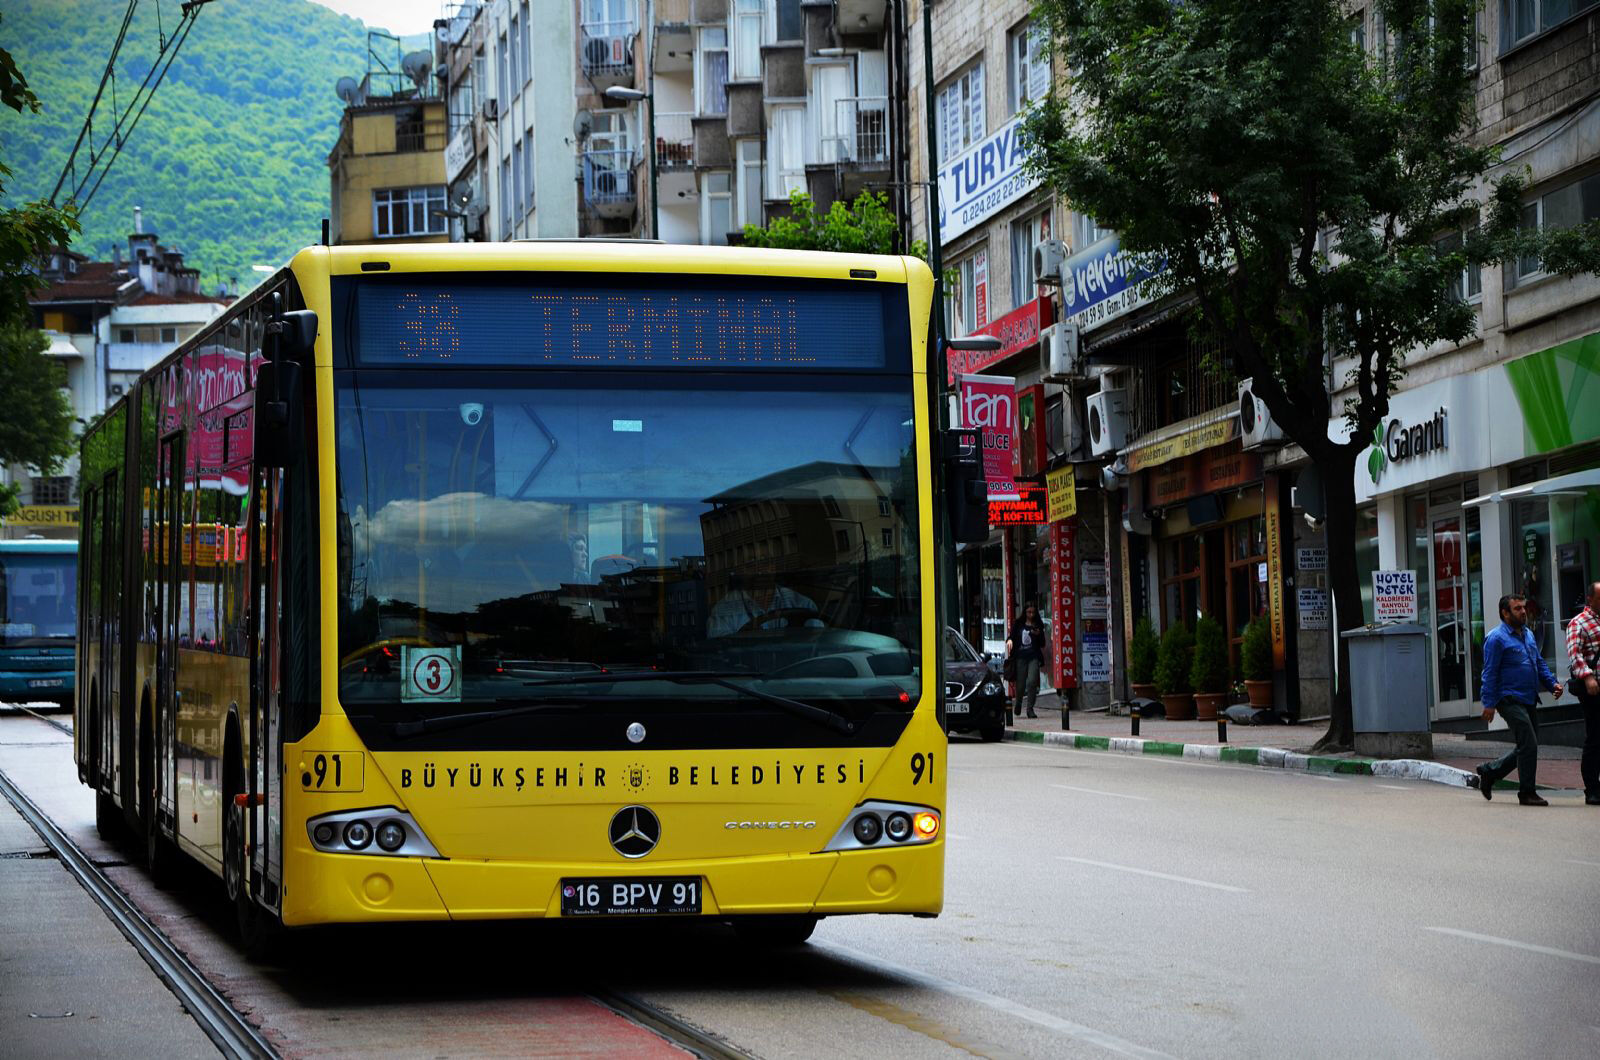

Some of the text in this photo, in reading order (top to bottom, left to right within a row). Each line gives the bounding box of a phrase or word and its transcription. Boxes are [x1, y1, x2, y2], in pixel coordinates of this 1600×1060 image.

[396, 293, 460, 358] 38
[965, 385, 1011, 429] tan
[1387, 405, 1446, 463] Garanti
[1376, 573, 1414, 584] HOTEL
[1376, 584, 1414, 595] PETEK
[426, 659, 441, 690] 3
[313, 754, 341, 788] 91
[401, 759, 864, 791] BÜYÜKŞEHİR BELEDİYESİ
[910, 752, 933, 786] 91
[724, 820, 816, 831] CONECTO
[576, 883, 697, 907] 16 BPV 91
